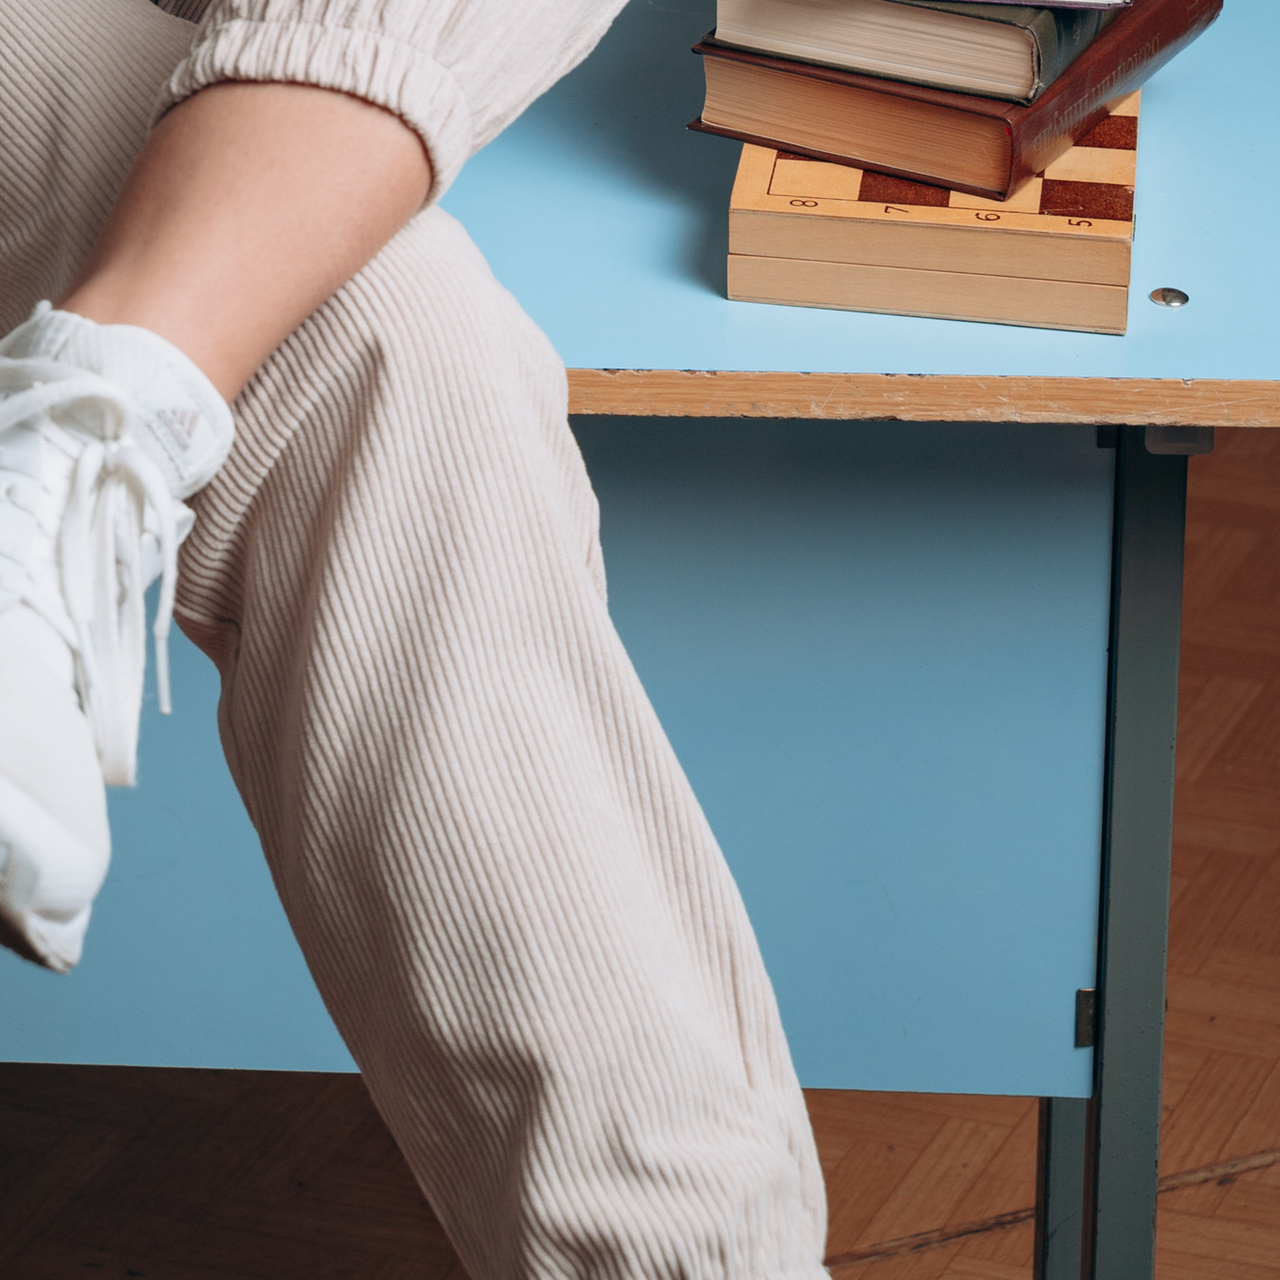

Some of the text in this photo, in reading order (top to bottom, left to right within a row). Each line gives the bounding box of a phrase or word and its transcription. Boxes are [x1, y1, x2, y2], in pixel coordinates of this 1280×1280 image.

[789, 198, 819, 208] 8
[884, 205, 910, 214] 7
[1068, 218, 1093, 228] 5
